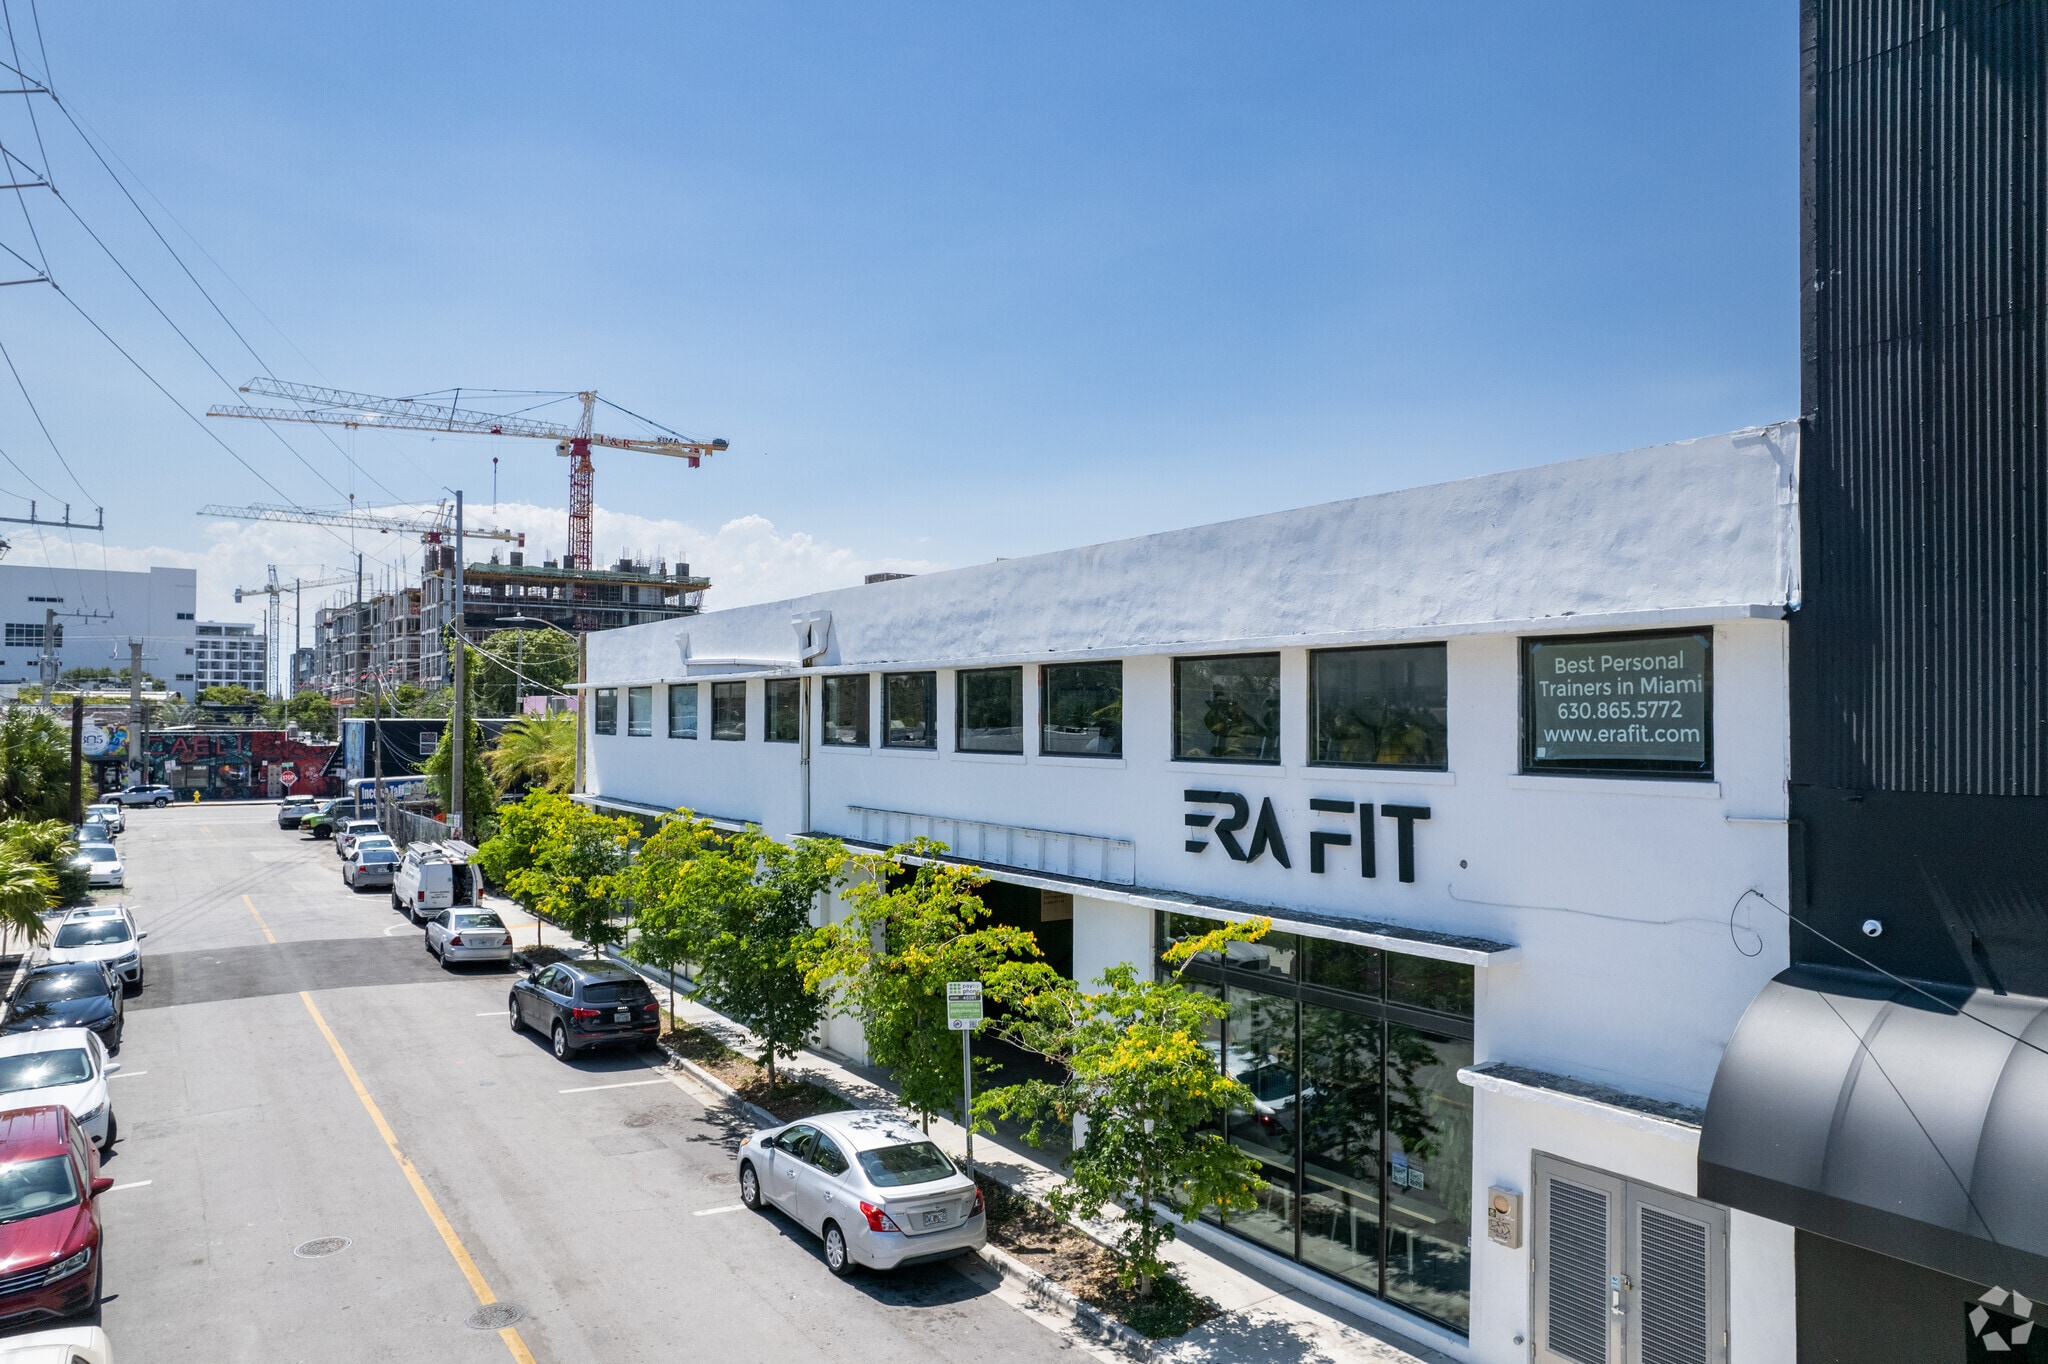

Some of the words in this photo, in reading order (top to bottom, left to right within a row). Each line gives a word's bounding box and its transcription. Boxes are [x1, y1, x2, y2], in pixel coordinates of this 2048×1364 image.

[1554, 656, 1595, 674] Best
[1601, 650, 1684, 673] Personal
[1539, 678, 1612, 697] Trainers
[1617, 677, 1634, 695] in
[1640, 674, 1702, 694] Miami
[1558, 700, 1682, 720] 630.865.5772
[1544, 724, 1700, 743] www.erafit.com
[1184, 789, 1292, 869] ERA
[1309, 798, 1431, 883] FIT
